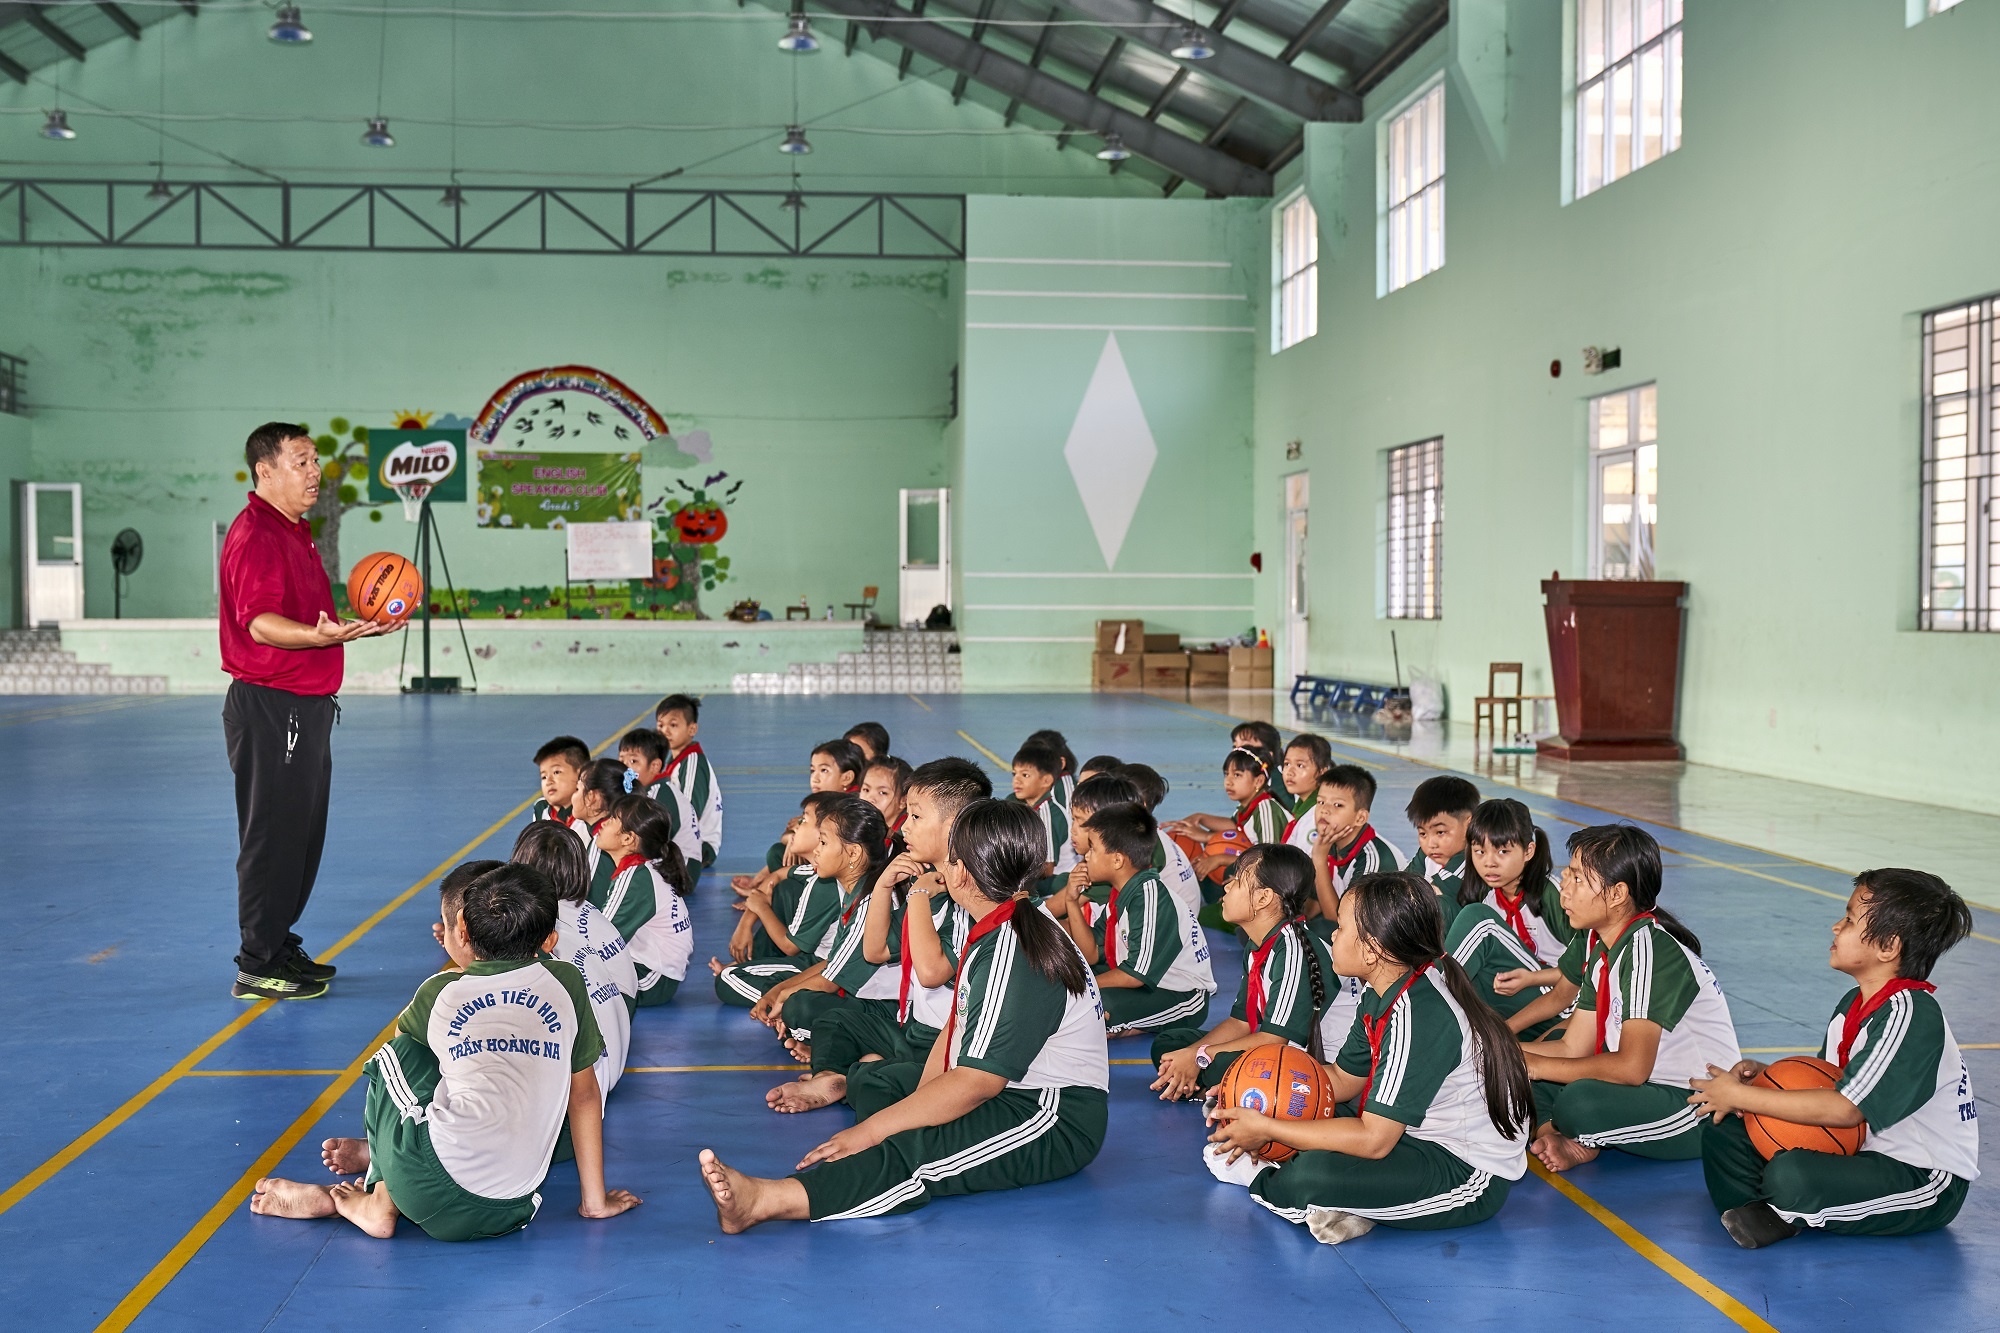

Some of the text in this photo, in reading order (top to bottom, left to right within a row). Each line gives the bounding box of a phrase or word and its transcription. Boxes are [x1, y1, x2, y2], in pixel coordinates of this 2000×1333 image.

[390, 454, 450, 476] MILO
[533, 467, 586, 479] ENGLISH
[512, 484, 607, 497] SPEAKING CLUB
[447, 987, 562, 1037] TRƯỜNG TIỂU HỌC
[486, 1033, 540, 1056] HOÀNG
[543, 1041, 560, 1060] NA
